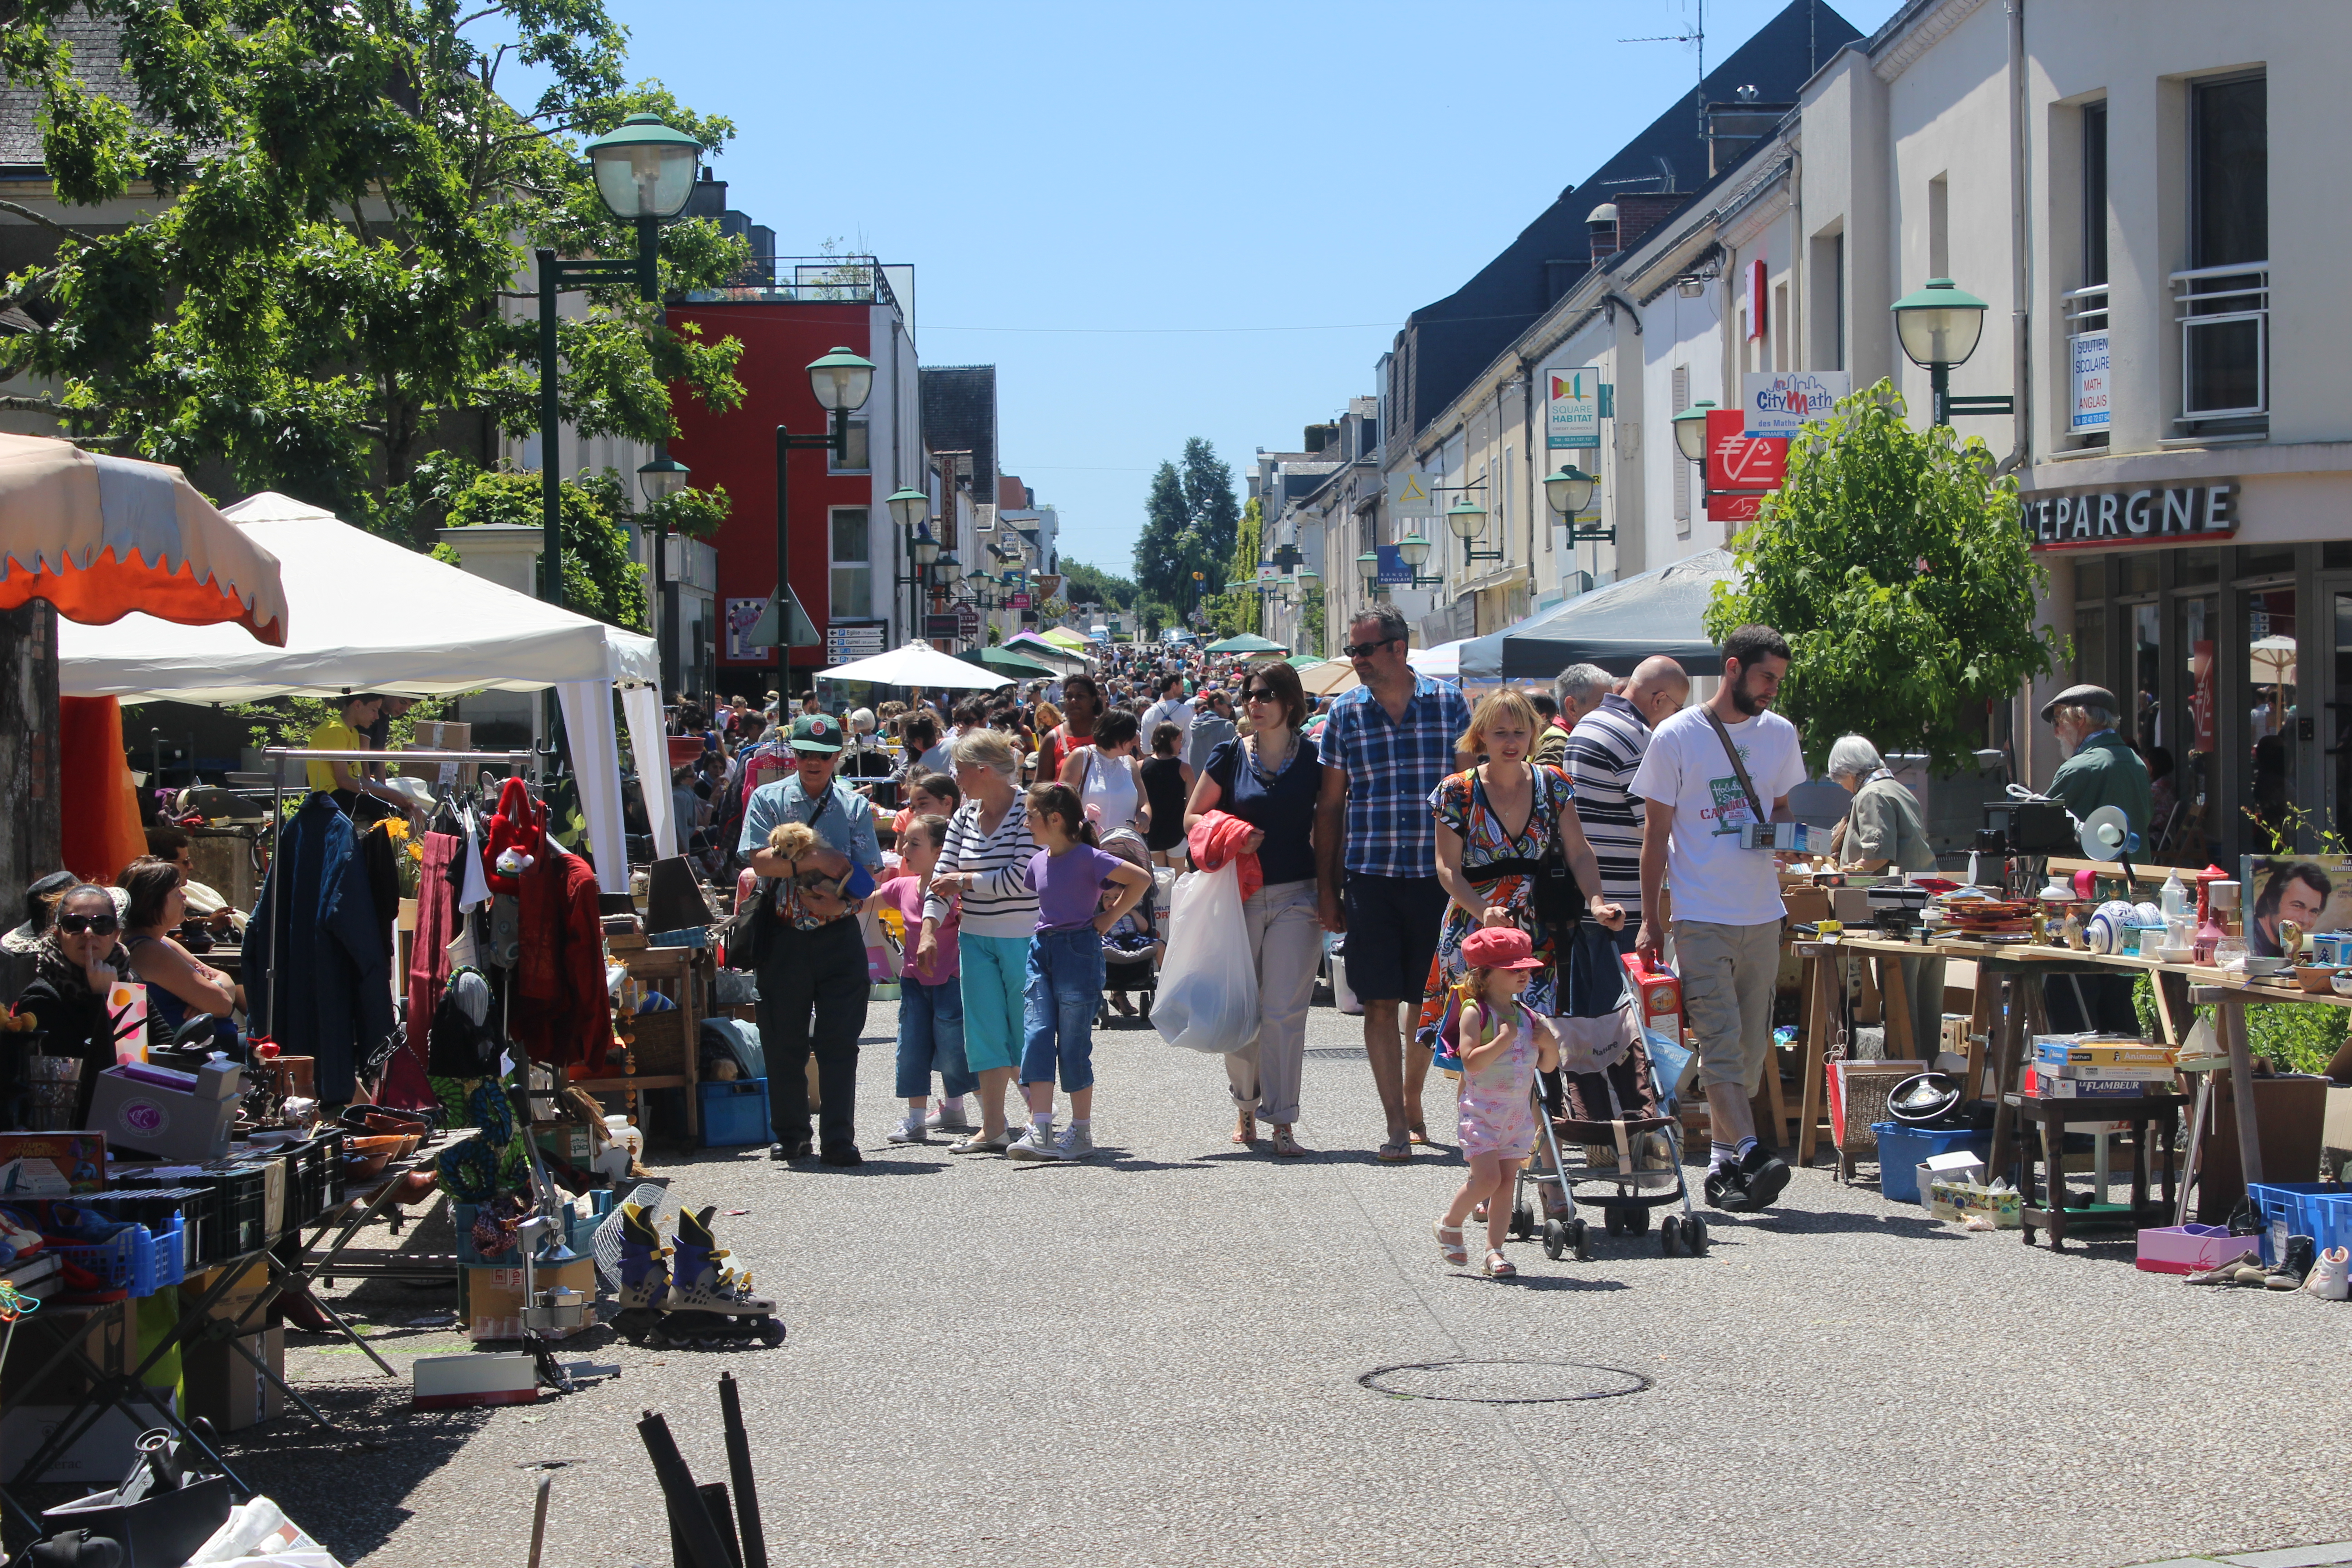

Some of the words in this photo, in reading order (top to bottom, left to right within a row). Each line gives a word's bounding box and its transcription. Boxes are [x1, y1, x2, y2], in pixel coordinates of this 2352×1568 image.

[2078, 338, 2108, 354] SOUTIEN
[2084, 377, 2102, 392] MATH
[2079, 394, 2107, 409] ANGLAIS
[1552, 405, 1592, 414] SQUARE
[1553, 415, 1592, 423] HABITAT
[944, 459, 953, 548] BOULANGERIE
[1592, 1040, 1618, 1057] Nature
[2124, 1051, 2163, 1060] Animaux
[2086, 1081, 2139, 1091] FLAMBEUR
[7, 1147, 61, 1157] INVADERS
